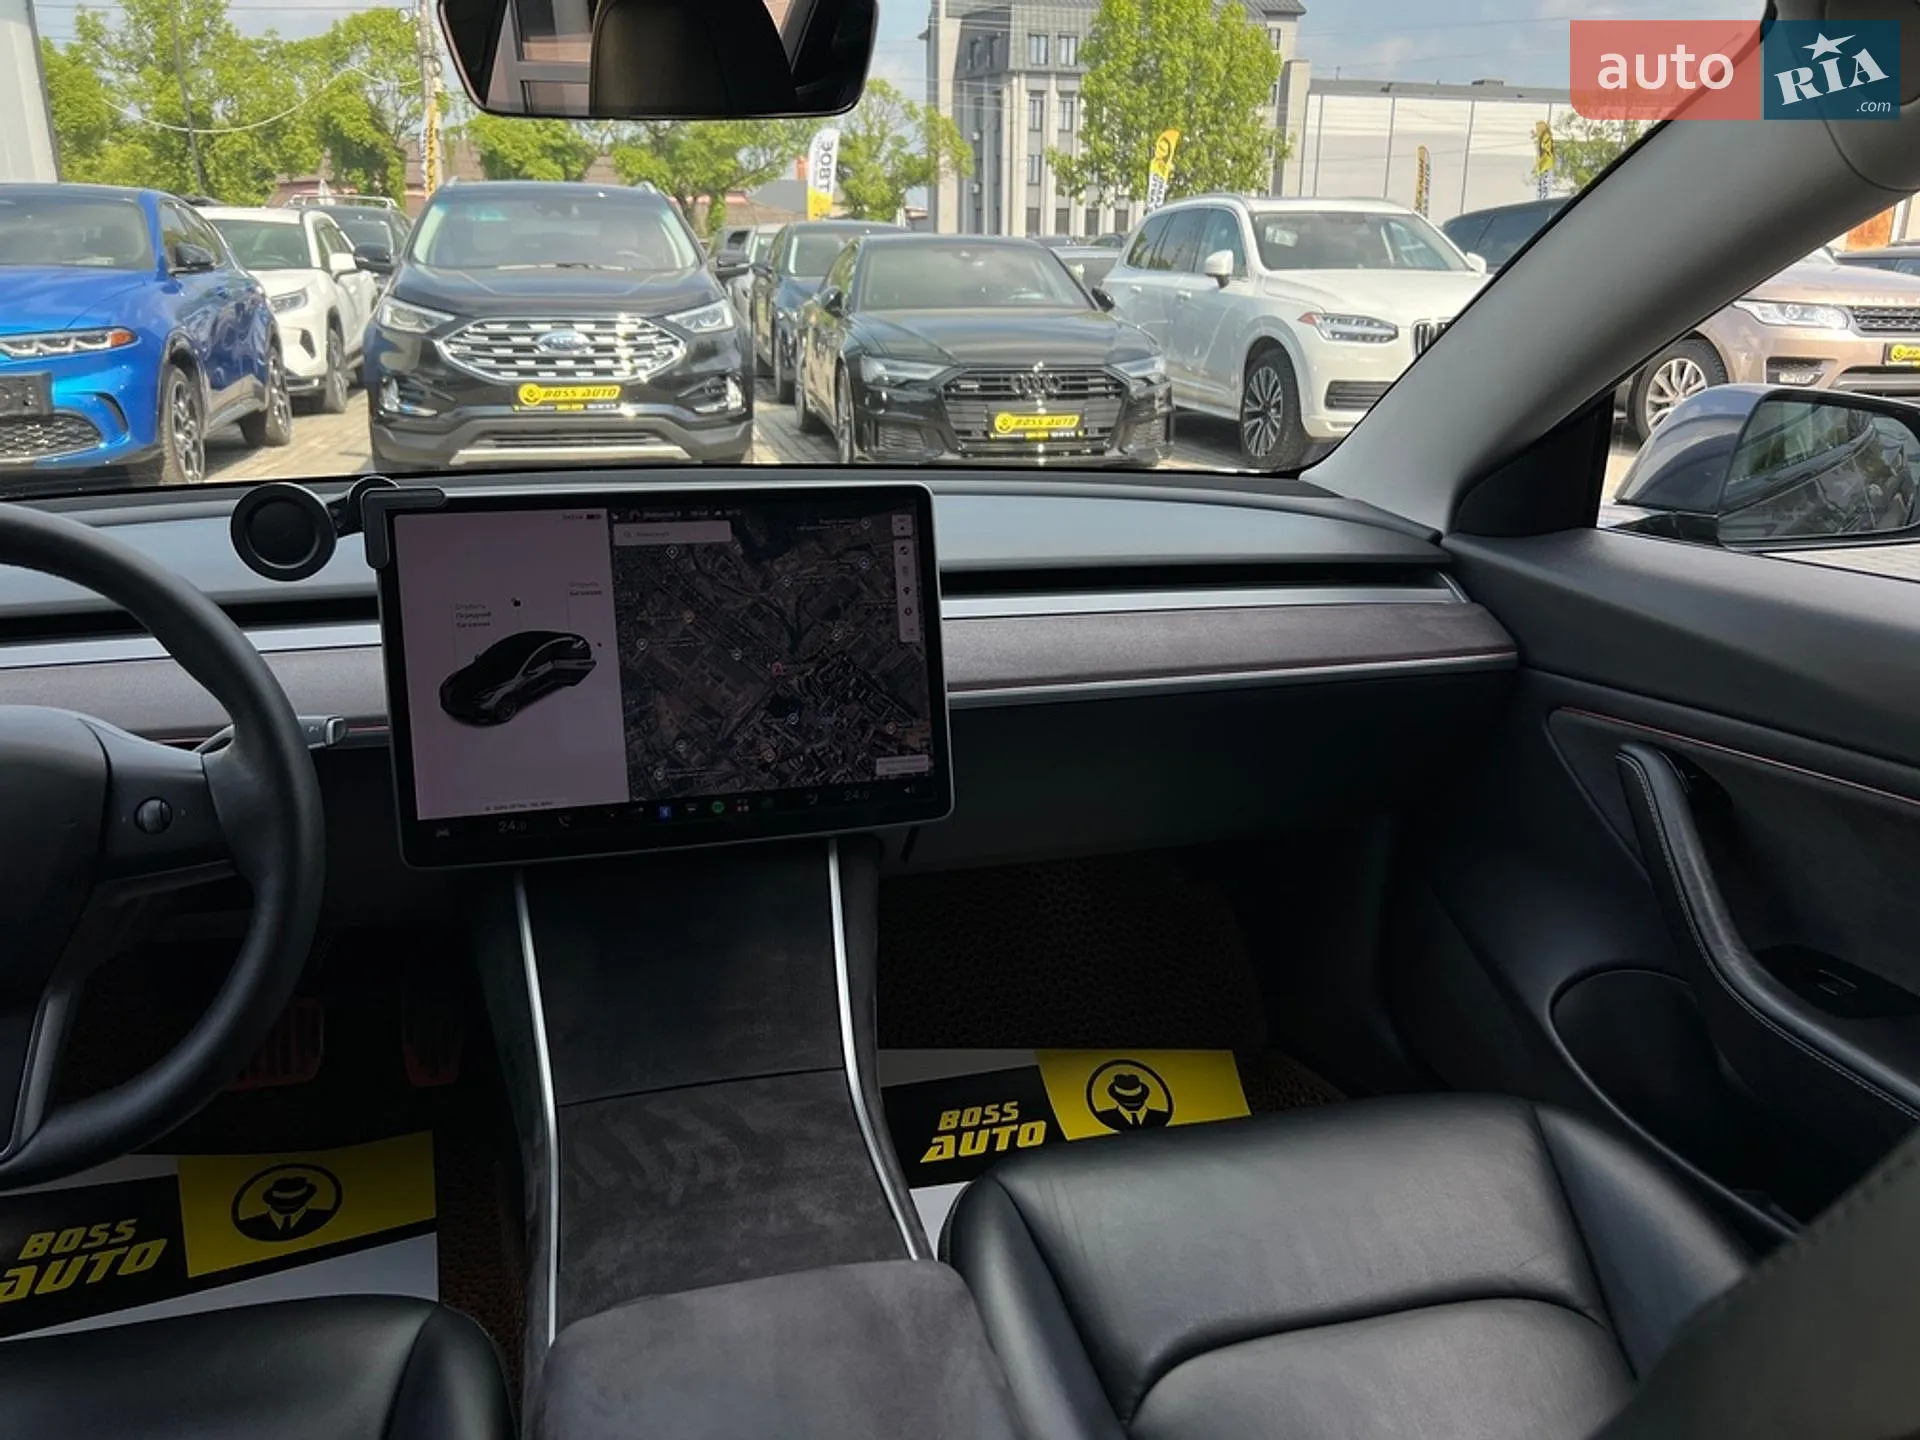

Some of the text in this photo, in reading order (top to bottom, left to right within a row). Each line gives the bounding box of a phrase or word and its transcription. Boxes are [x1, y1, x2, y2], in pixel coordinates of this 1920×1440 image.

[543, 388, 617, 398] BOSS AUTO
[938, 1101, 1019, 1131] BOSS
[920, 1120, 1047, 1163] AUTO
[18, 1218, 138, 1260] BOSS
[0, 1238, 168, 1304] AUTO
